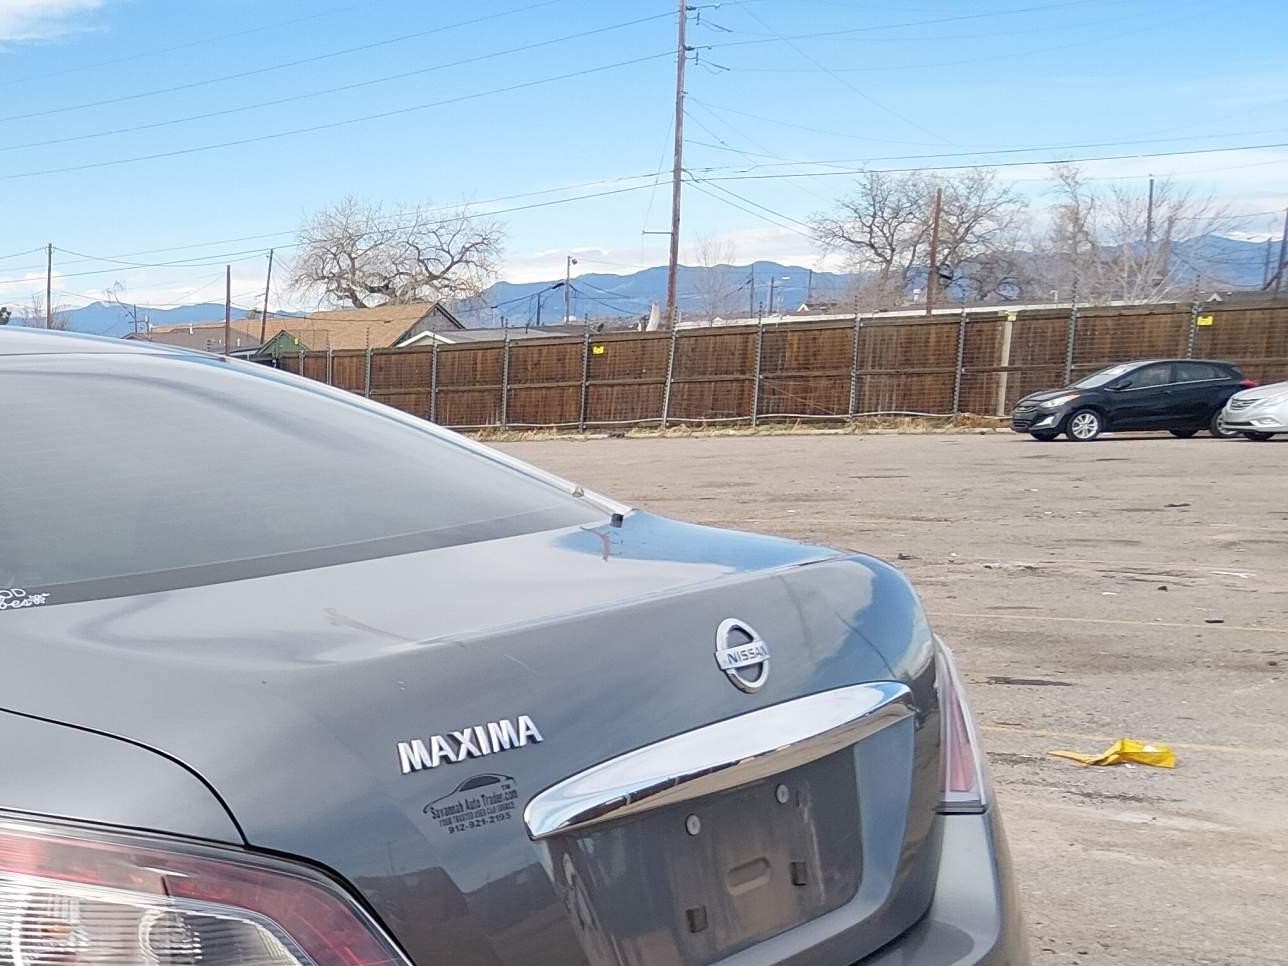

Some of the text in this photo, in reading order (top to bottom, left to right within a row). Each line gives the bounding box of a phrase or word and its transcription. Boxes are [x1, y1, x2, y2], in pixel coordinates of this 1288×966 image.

[727, 645, 768, 665] NISSAN
[397, 714, 544, 774] MAXIMA
[430, 800, 465, 820] Savannah
[464, 798, 481, 811] Auto
